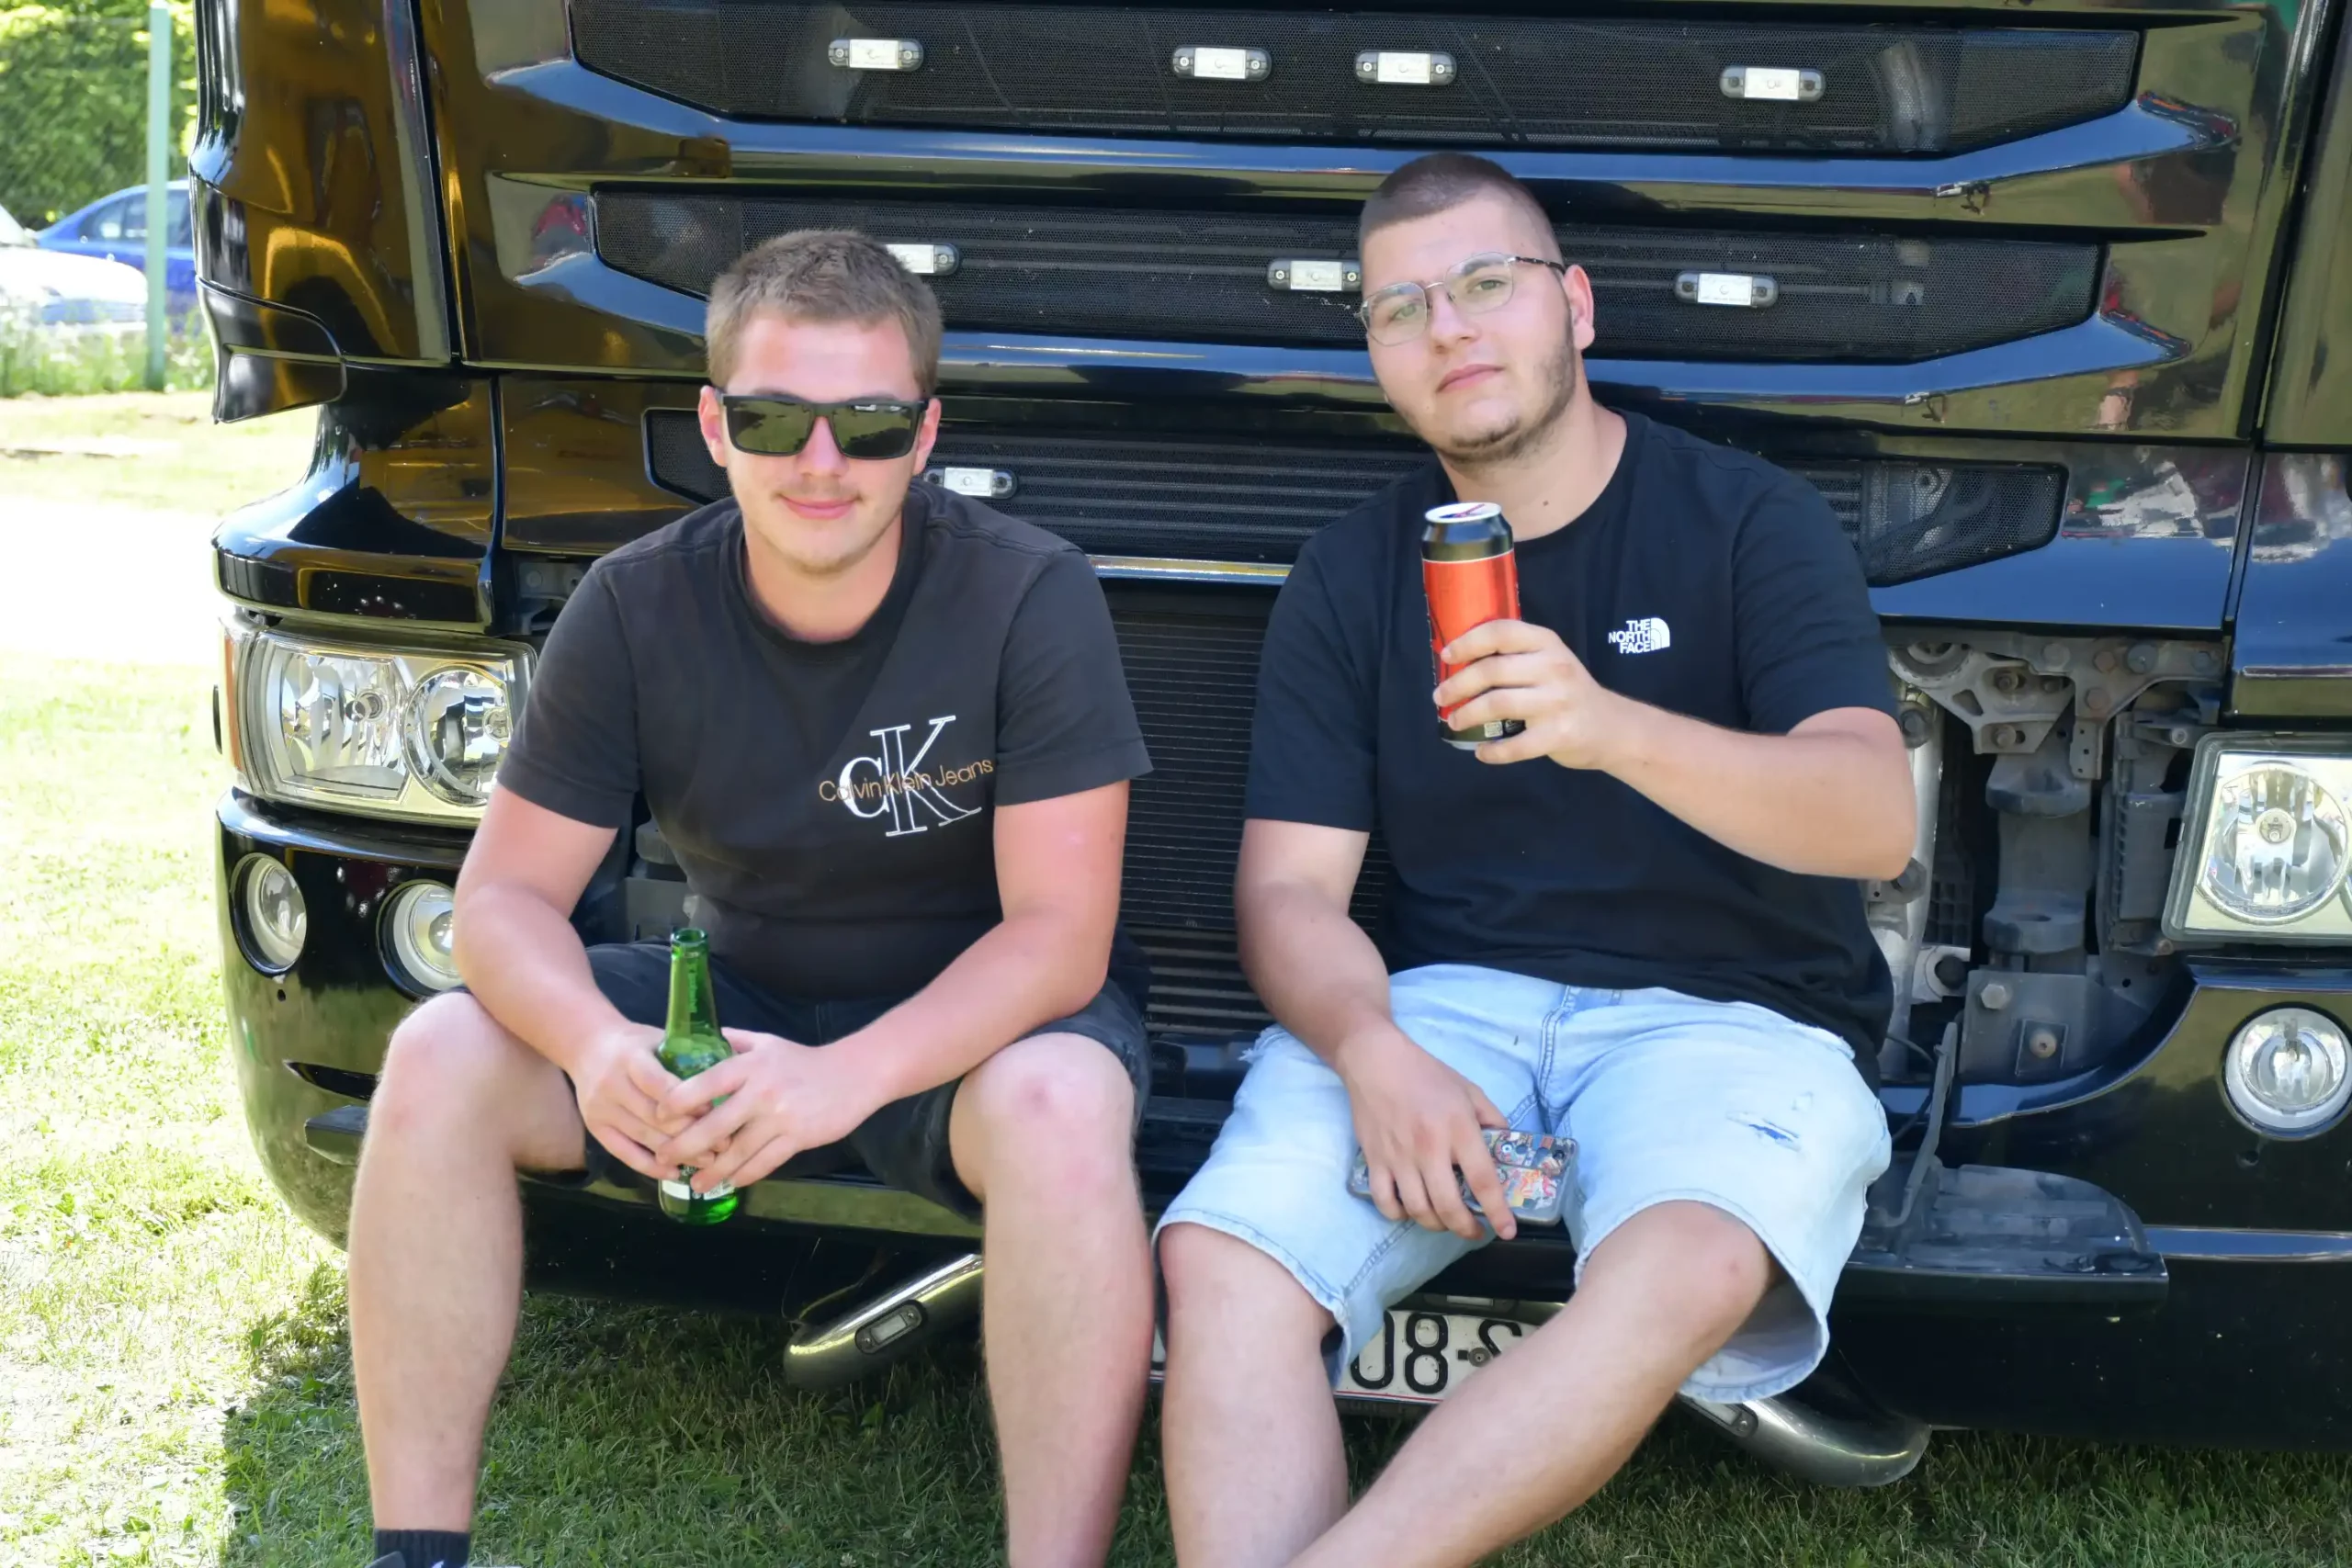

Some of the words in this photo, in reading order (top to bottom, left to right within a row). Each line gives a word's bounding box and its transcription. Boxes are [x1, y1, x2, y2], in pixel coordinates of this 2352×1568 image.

[1625, 618, 1651, 632] THE
[1608, 630, 1651, 644] NORTH
[1620, 641, 1651, 654] FACE
[819, 777, 882, 802] Calvin
[884, 771, 932, 795] Klein
[935, 760, 994, 787] Jeans
[839, 715, 982, 837] CK
